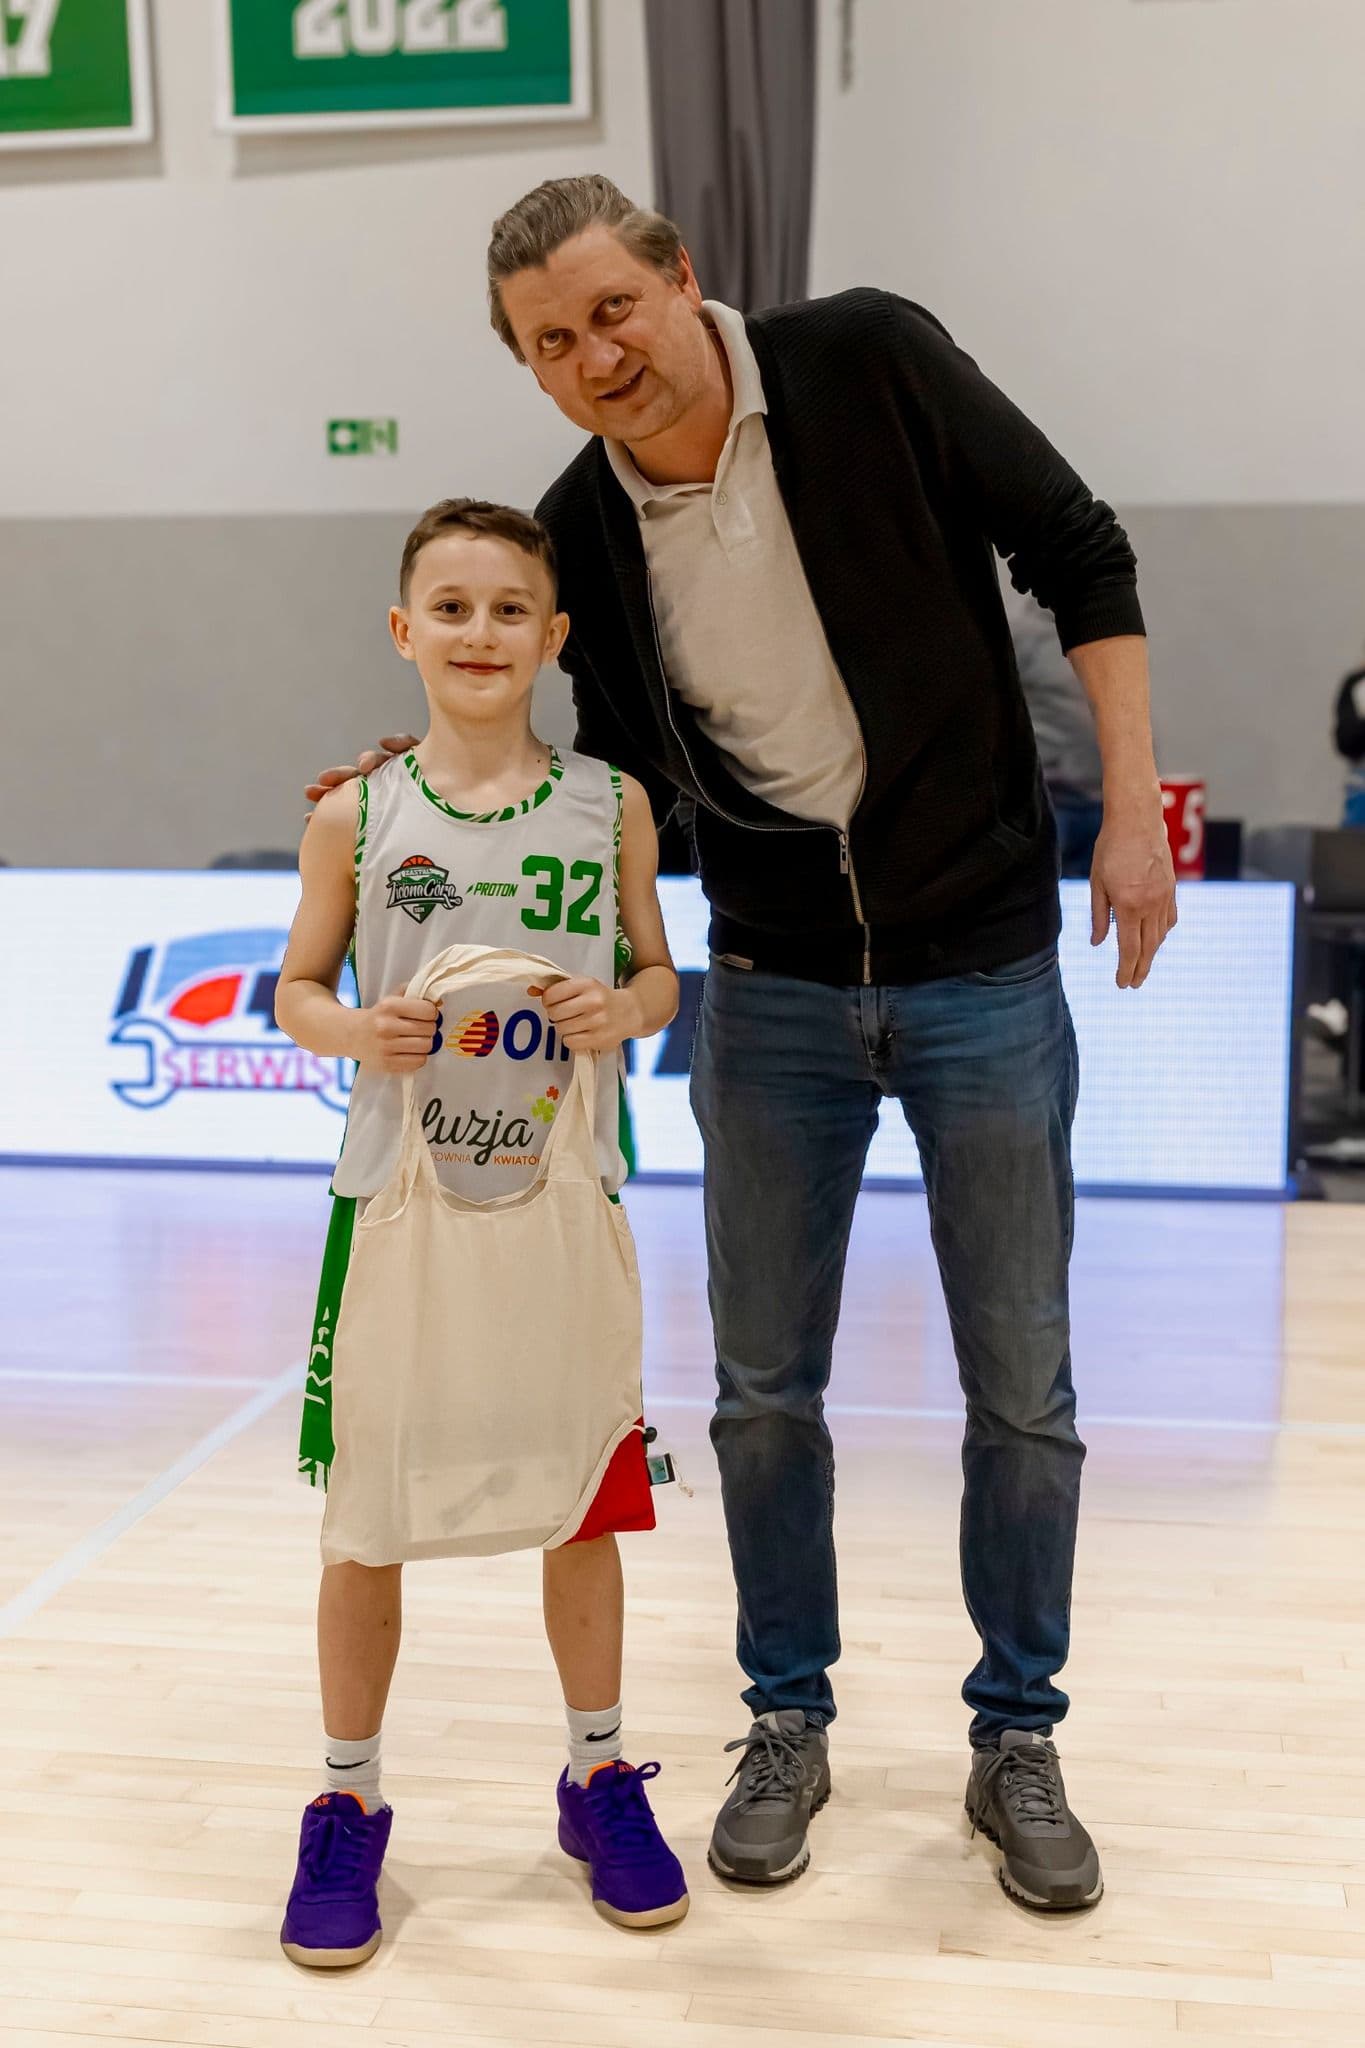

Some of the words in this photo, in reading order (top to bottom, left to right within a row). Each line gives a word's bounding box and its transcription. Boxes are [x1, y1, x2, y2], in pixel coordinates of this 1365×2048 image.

[0, 0, 59, 78] 7
[292, 0, 508, 58] 2022
[473, 882, 519, 897] PROTON
[521, 855, 603, 936] 32
[162, 1049, 334, 1088] SERWIS
[494, 1152, 540, 1166] KWIATÓ
